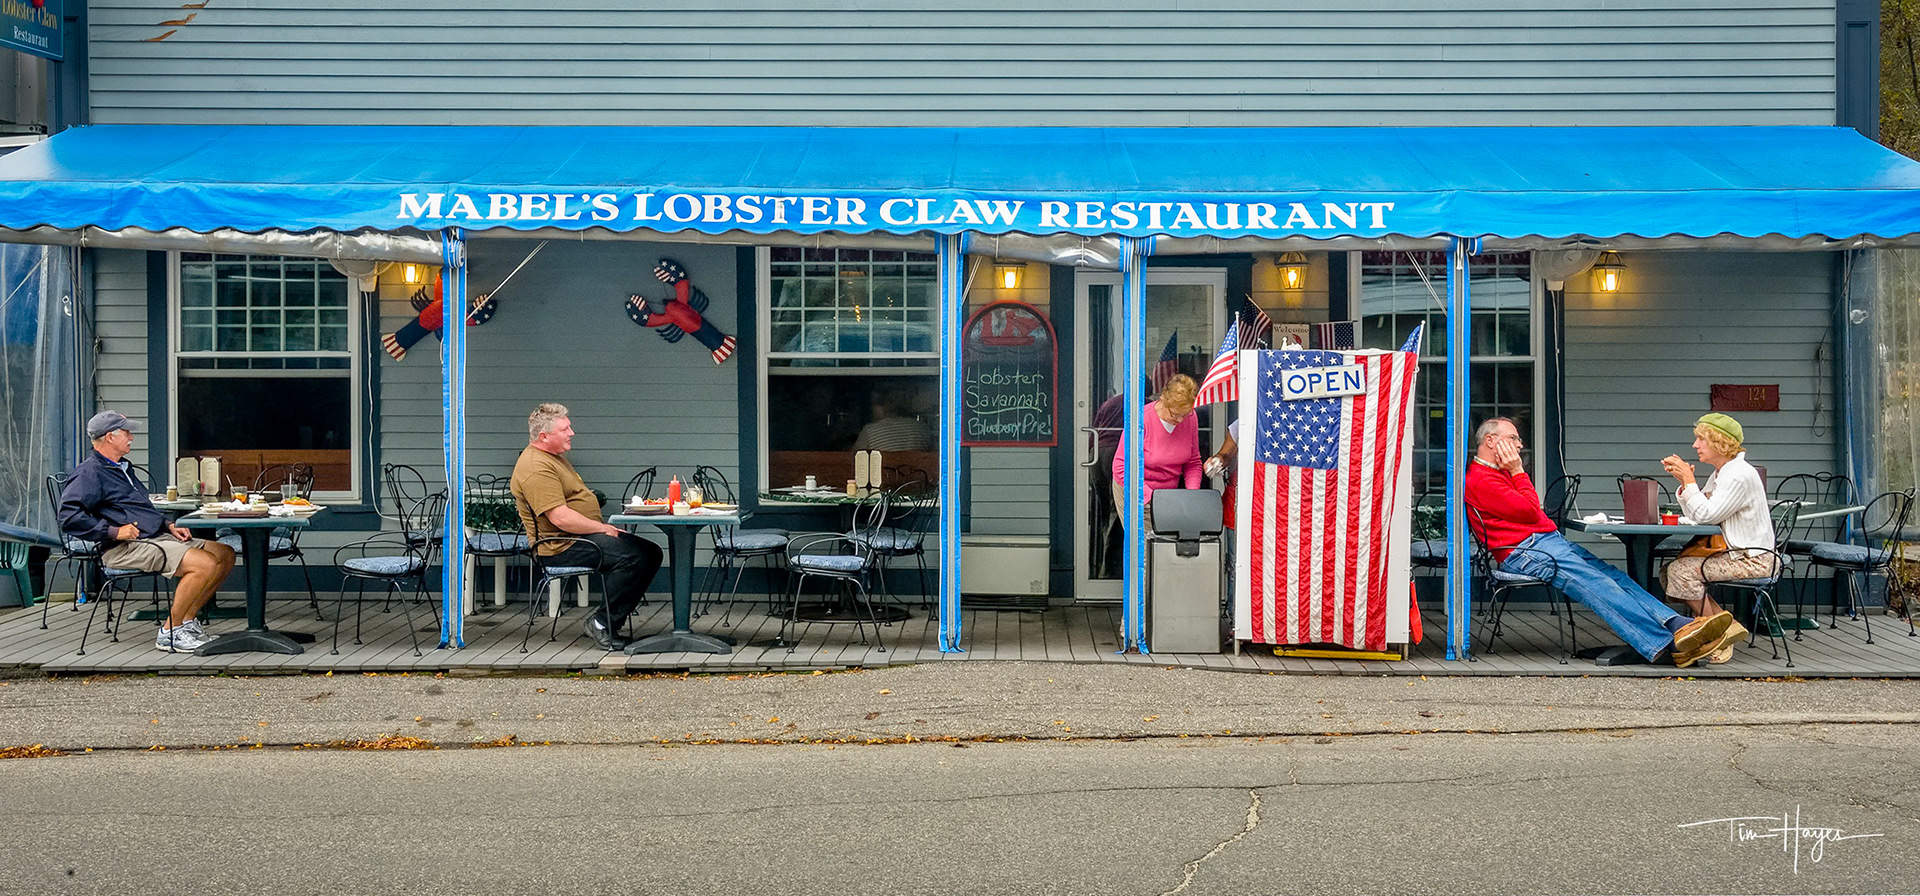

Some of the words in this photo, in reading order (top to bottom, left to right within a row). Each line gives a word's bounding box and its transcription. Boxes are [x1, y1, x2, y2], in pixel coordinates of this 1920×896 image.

[2, 0, 36, 22] Lobster
[38, 6, 57, 29] Claw
[14, 25, 48, 48] Restaurant
[396, 192, 618, 222] MABEL'S
[633, 193, 867, 225] LOBSTER
[879, 198, 1025, 226] CLAW
[1038, 201, 1395, 230] RESTAURANT
[1273, 325, 1309, 334] Welcome
[966, 366, 1044, 385] Lobster
[1287, 370, 1361, 394] OPEN
[966, 386, 1048, 409] Savannah
[1748, 387, 1766, 401] 124
